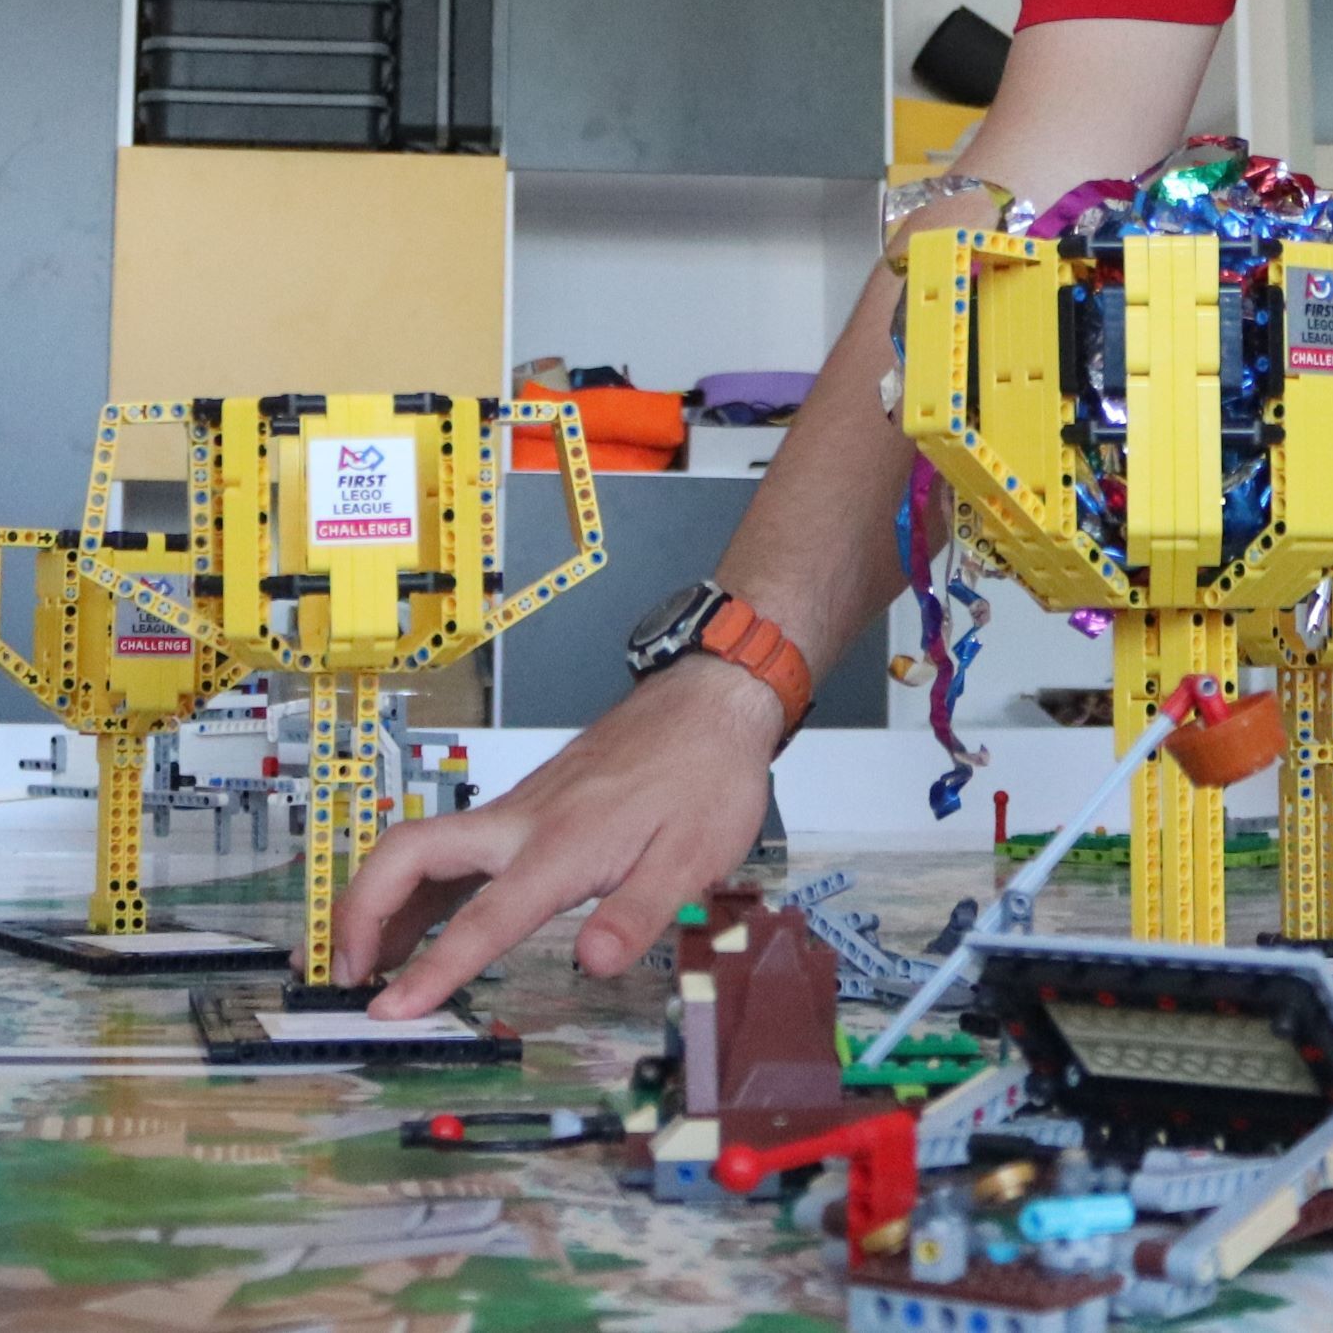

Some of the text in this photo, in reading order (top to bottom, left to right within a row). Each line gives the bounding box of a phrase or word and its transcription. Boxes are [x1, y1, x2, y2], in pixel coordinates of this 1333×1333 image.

[338, 474, 387, 488] FIRST
[341, 489, 382, 502] LEGO
[332, 502, 393, 516] LEAGUE
[318, 522, 408, 538] CHALLENGE
[131, 624, 178, 634] LEAGUE
[120, 641, 188, 651] CHALLENGE
